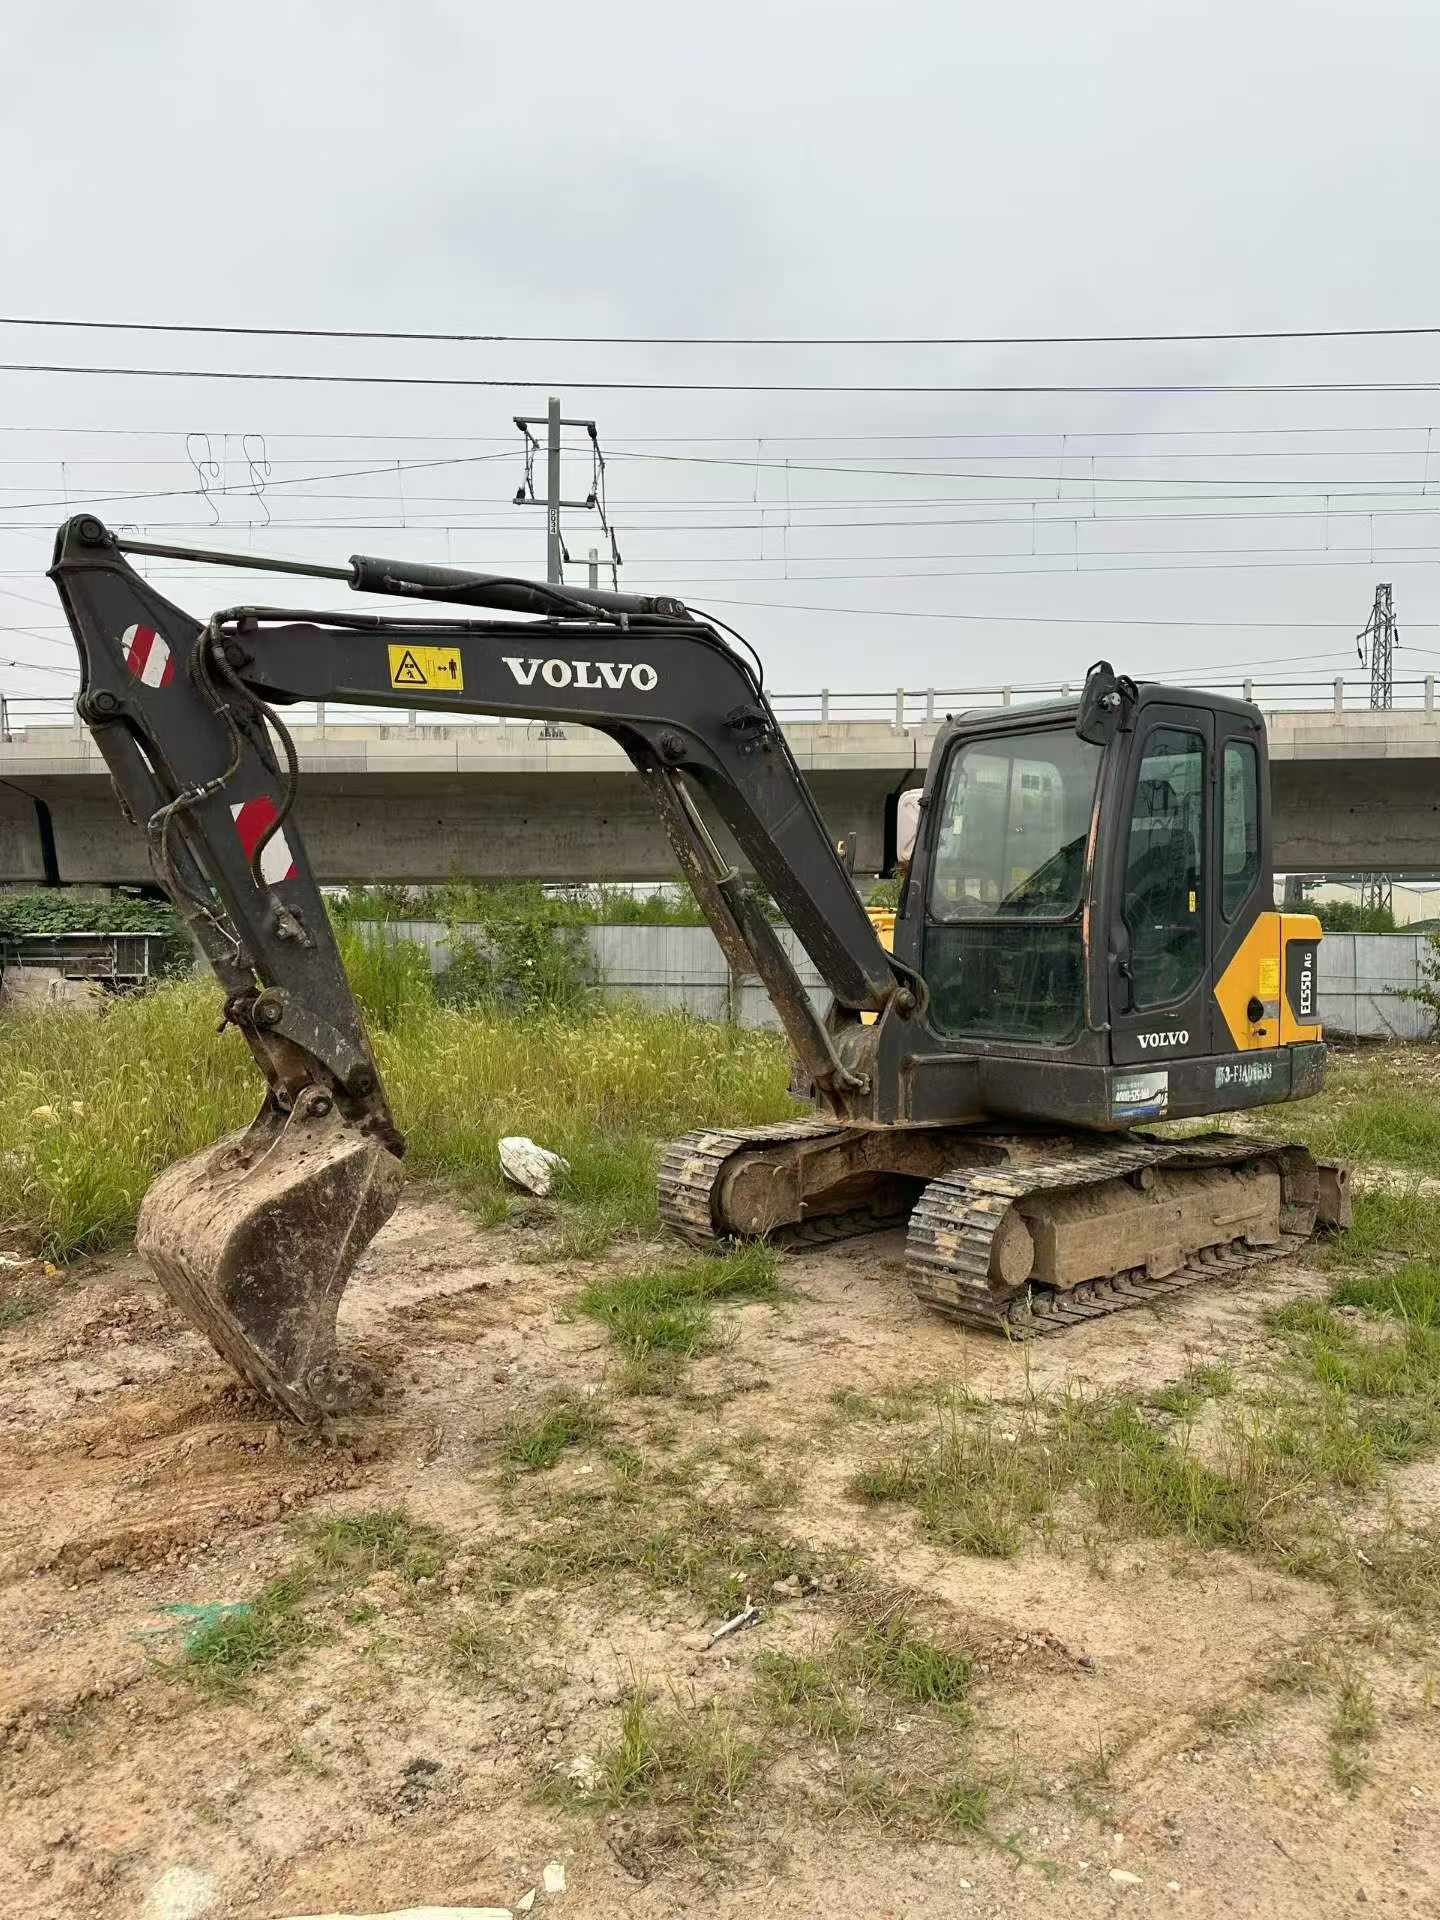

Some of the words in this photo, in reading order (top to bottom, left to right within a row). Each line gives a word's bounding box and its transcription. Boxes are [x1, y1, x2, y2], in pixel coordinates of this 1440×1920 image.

[501, 657, 658, 691] VOLVO
[1300, 970, 1312, 1014] EC55D
[1137, 1030, 1189, 1048] VOLVO
